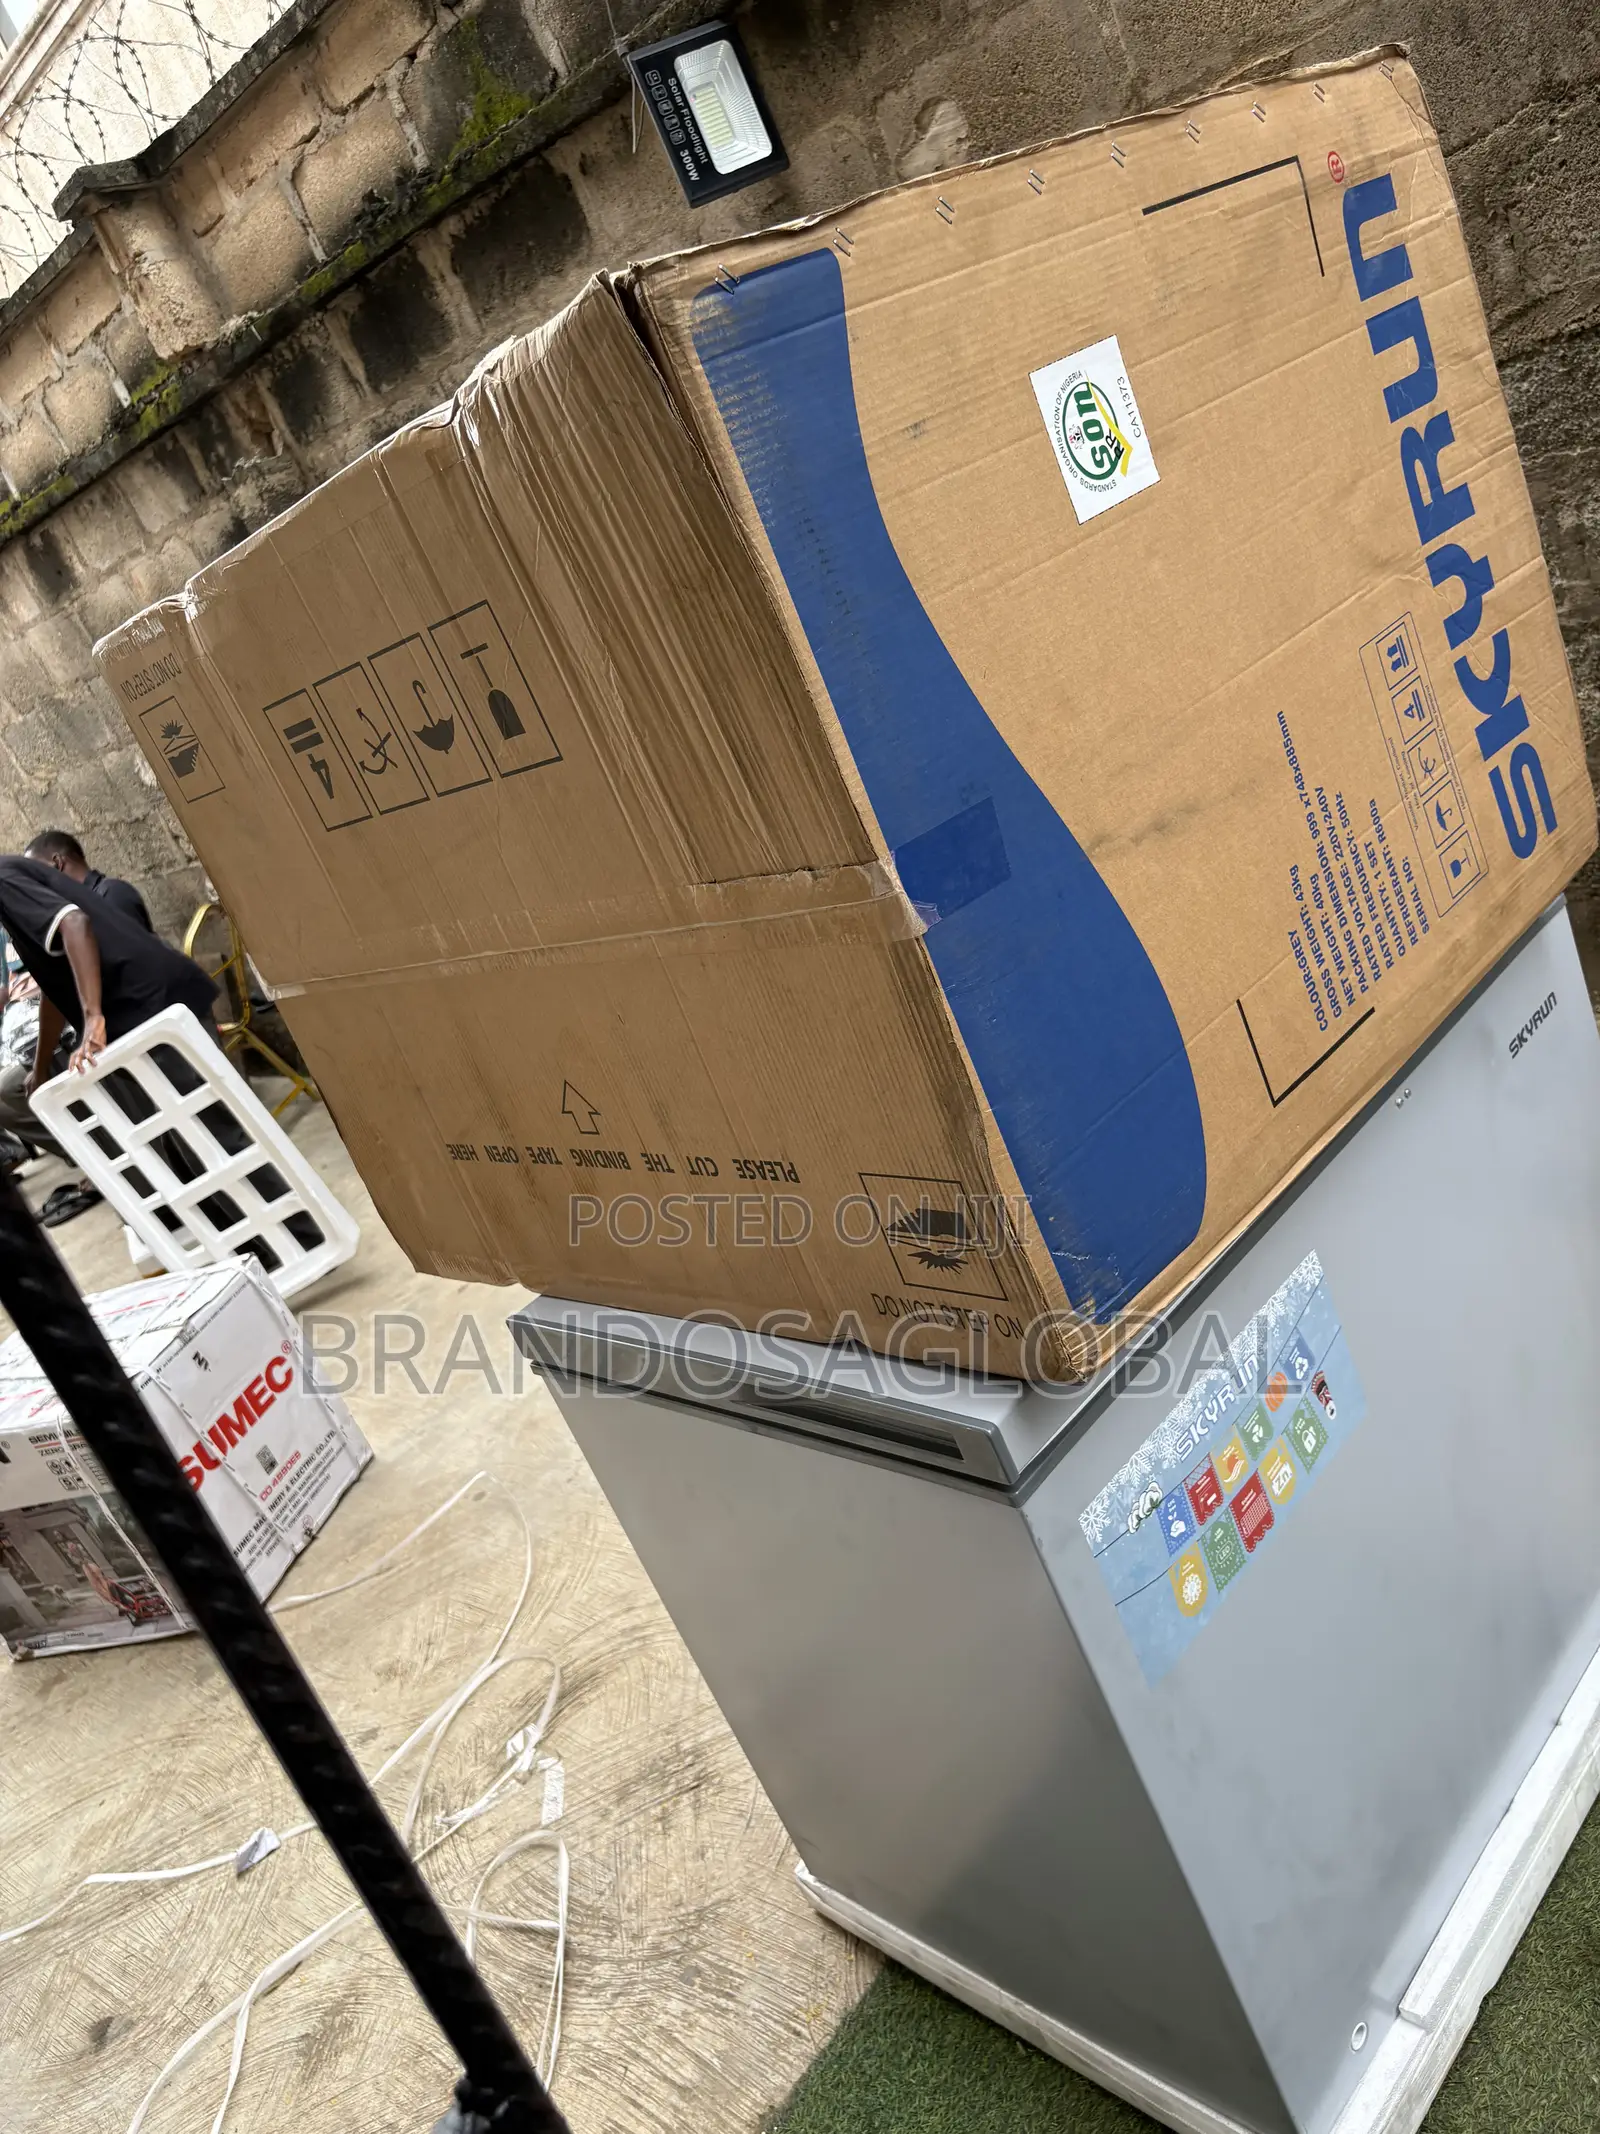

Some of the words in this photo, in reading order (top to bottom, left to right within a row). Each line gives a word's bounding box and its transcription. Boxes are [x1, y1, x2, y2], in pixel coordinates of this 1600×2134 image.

[668, 77, 685, 112] Solar
[681, 109, 709, 164] Floodlight
[680, 149, 700, 181] 300W
[1055, 393, 1062, 406] OF
[1060, 370, 1084, 393] NIGERIA
[1117, 376, 1142, 438] CA11373
[1054, 406, 1078, 479] ORGANISATION
[1080, 477, 1117, 493] STANDARDS
[132, 668, 155, 696] STEP
[148, 659, 171, 687] NOT
[163, 652, 182, 677] DO
[120, 679, 138, 703] ON
[1277, 711, 1311, 809] x748x885mm
[1306, 811, 1320, 840] 999
[1315, 786, 1344, 861] 220V-240V
[1336, 791, 1350, 829] 50Hz
[1369, 798, 1386, 844] R600a
[1364, 841, 1378, 868] SET
[1402, 856, 1414, 883] NO:
[1289, 864, 1304, 902] 43kg
[1310, 873, 1324, 910] 40kg
[1316, 840, 1348, 928] DIMENSION:
[1346, 829, 1378, 922] FREQUENCY:
[1340, 862, 1366, 933] VOLTAGE:
[1382, 844, 1418, 946] REFRIGERANT:
[1410, 884, 1430, 934] SERIAL
[1300, 904, 1325, 969] WEIGHT:
[1378, 881, 1406, 957] QUANTITY:
[1320, 912, 1345, 976] WEIGHT:
[1343, 930, 1369, 994] PACKING
[1361, 934, 1382, 982] RATED
[1374, 923, 1394, 970] RATED
[1288, 930, 1328, 1031] COLOUR:GREY
[1320, 968, 1342, 1018] GROSS
[1340, 977, 1356, 1007] NET
[445, 1143, 480, 1162] HERE
[483, 1144, 520, 1164] OPEN
[525, 1146, 563, 1166] TAPE
[569, 1148, 632, 1171] BINDING
[640, 1152, 676, 1174] THE
[686, 1155, 719, 1177] CUT
[732, 1158, 801, 1184] PLEASE
[871, 1293, 900, 1318] DO
[899, 1298, 939, 1324] NOT
[940, 1304, 990, 1333] STEP
[994, 1313, 1027, 1340] ON
